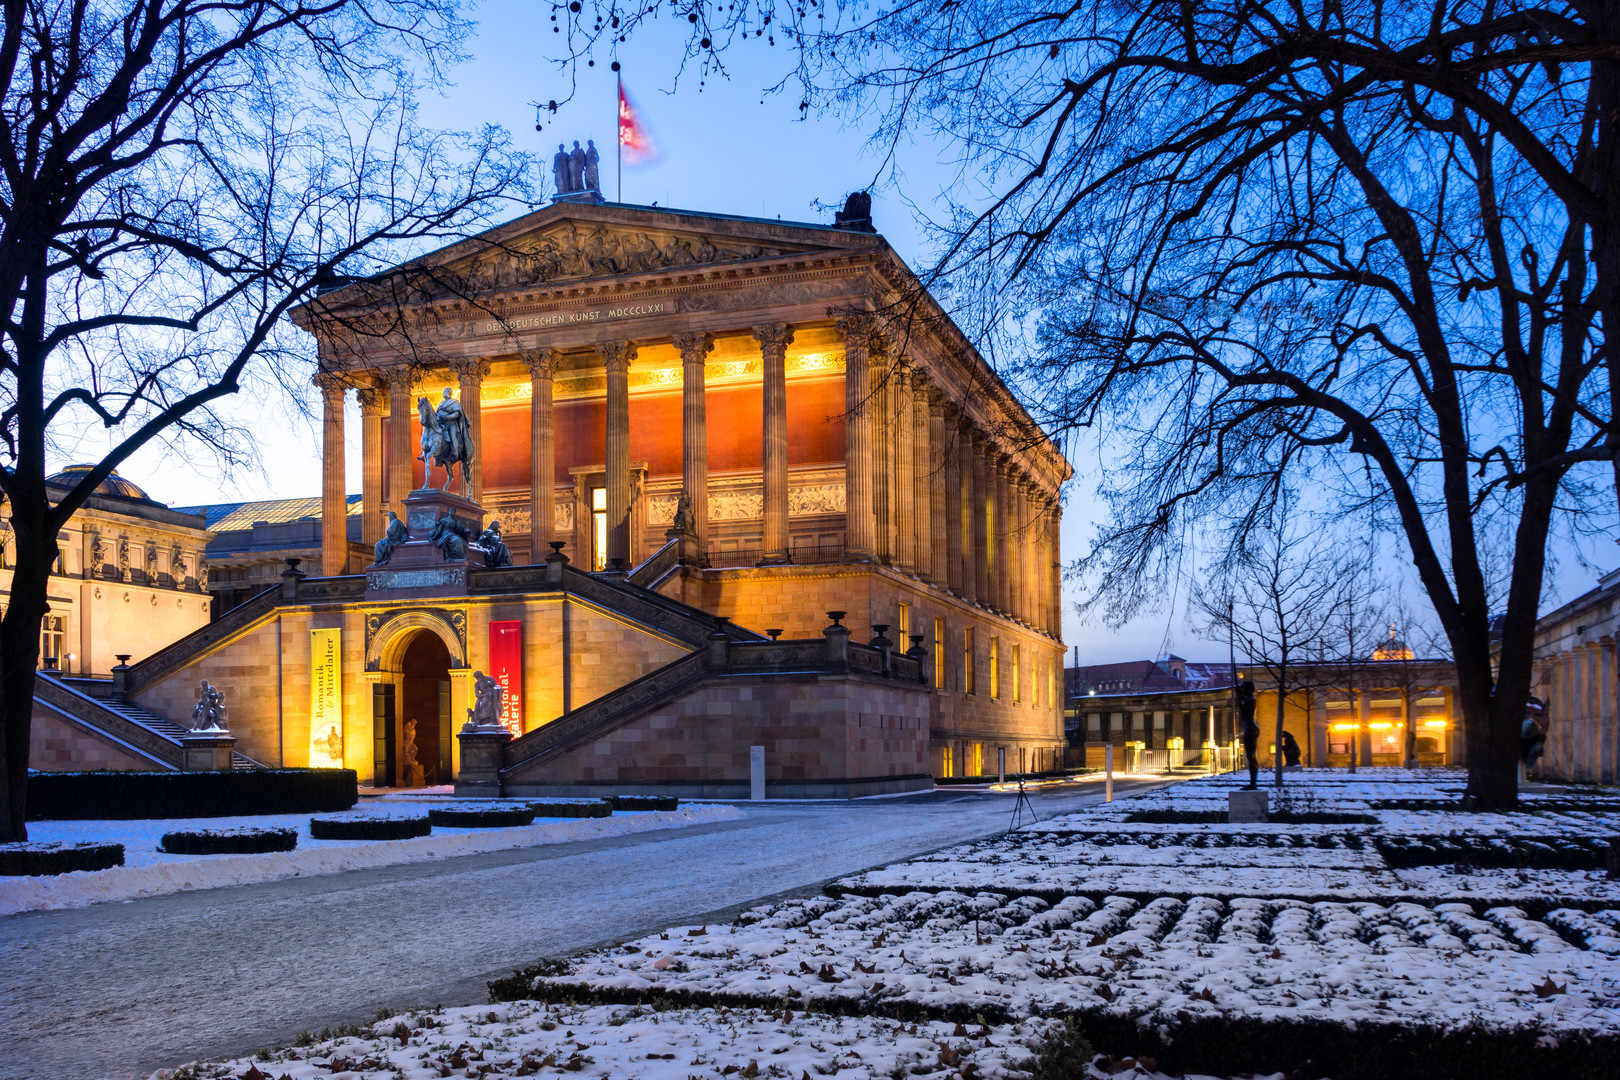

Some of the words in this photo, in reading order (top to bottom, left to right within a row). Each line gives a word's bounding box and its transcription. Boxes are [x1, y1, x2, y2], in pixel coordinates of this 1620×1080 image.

[509, 315, 565, 329] DEUTSCHEN
[569, 311, 600, 322] KUNST
[608, 303, 664, 318] MDCCCLXXI
[325, 638, 334, 697] Mittelalter
[315, 665, 324, 718] Romantik
[325, 699, 335, 709] &
[509, 694, 522, 738] galerie
